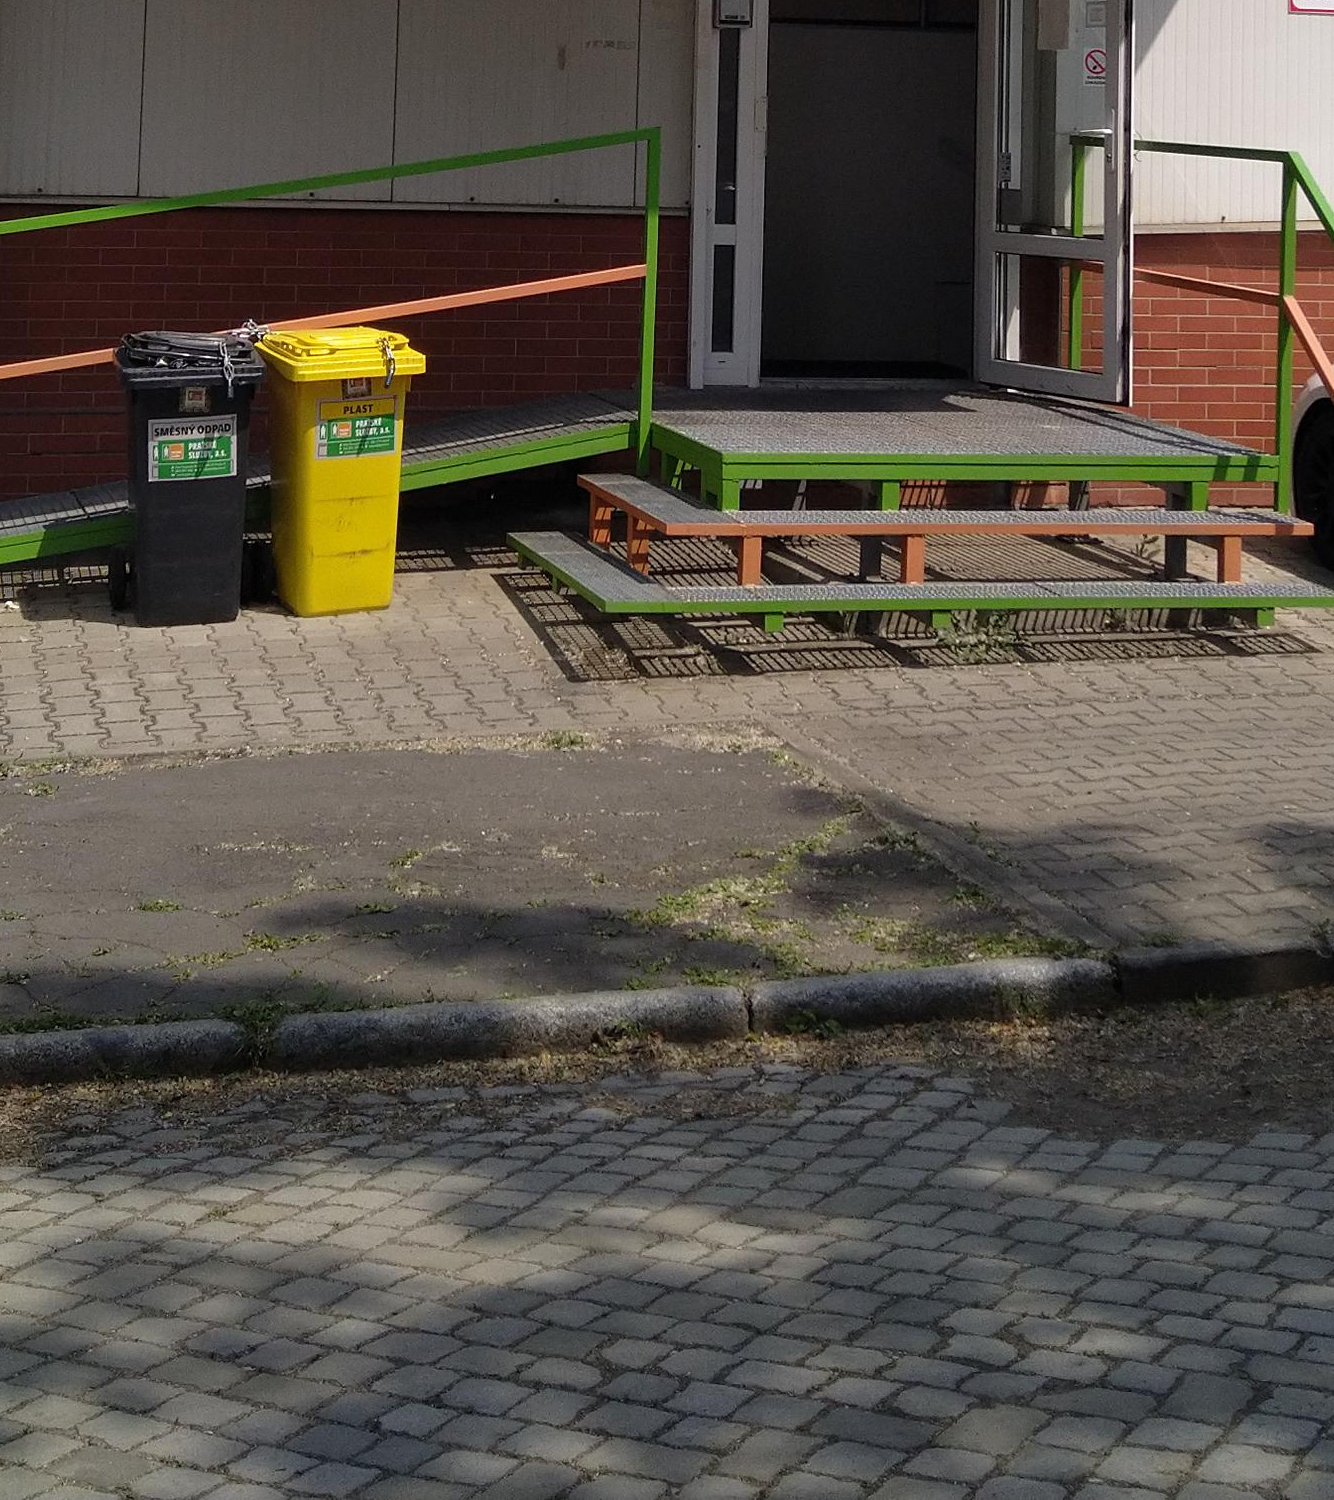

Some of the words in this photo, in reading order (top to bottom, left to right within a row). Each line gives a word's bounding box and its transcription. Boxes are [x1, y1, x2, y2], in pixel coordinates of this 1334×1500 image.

[343, 404, 373, 414] PLAST
[154, 424, 195, 436] SMĚSNÝ
[197, 423, 231, 434] ODPAD
